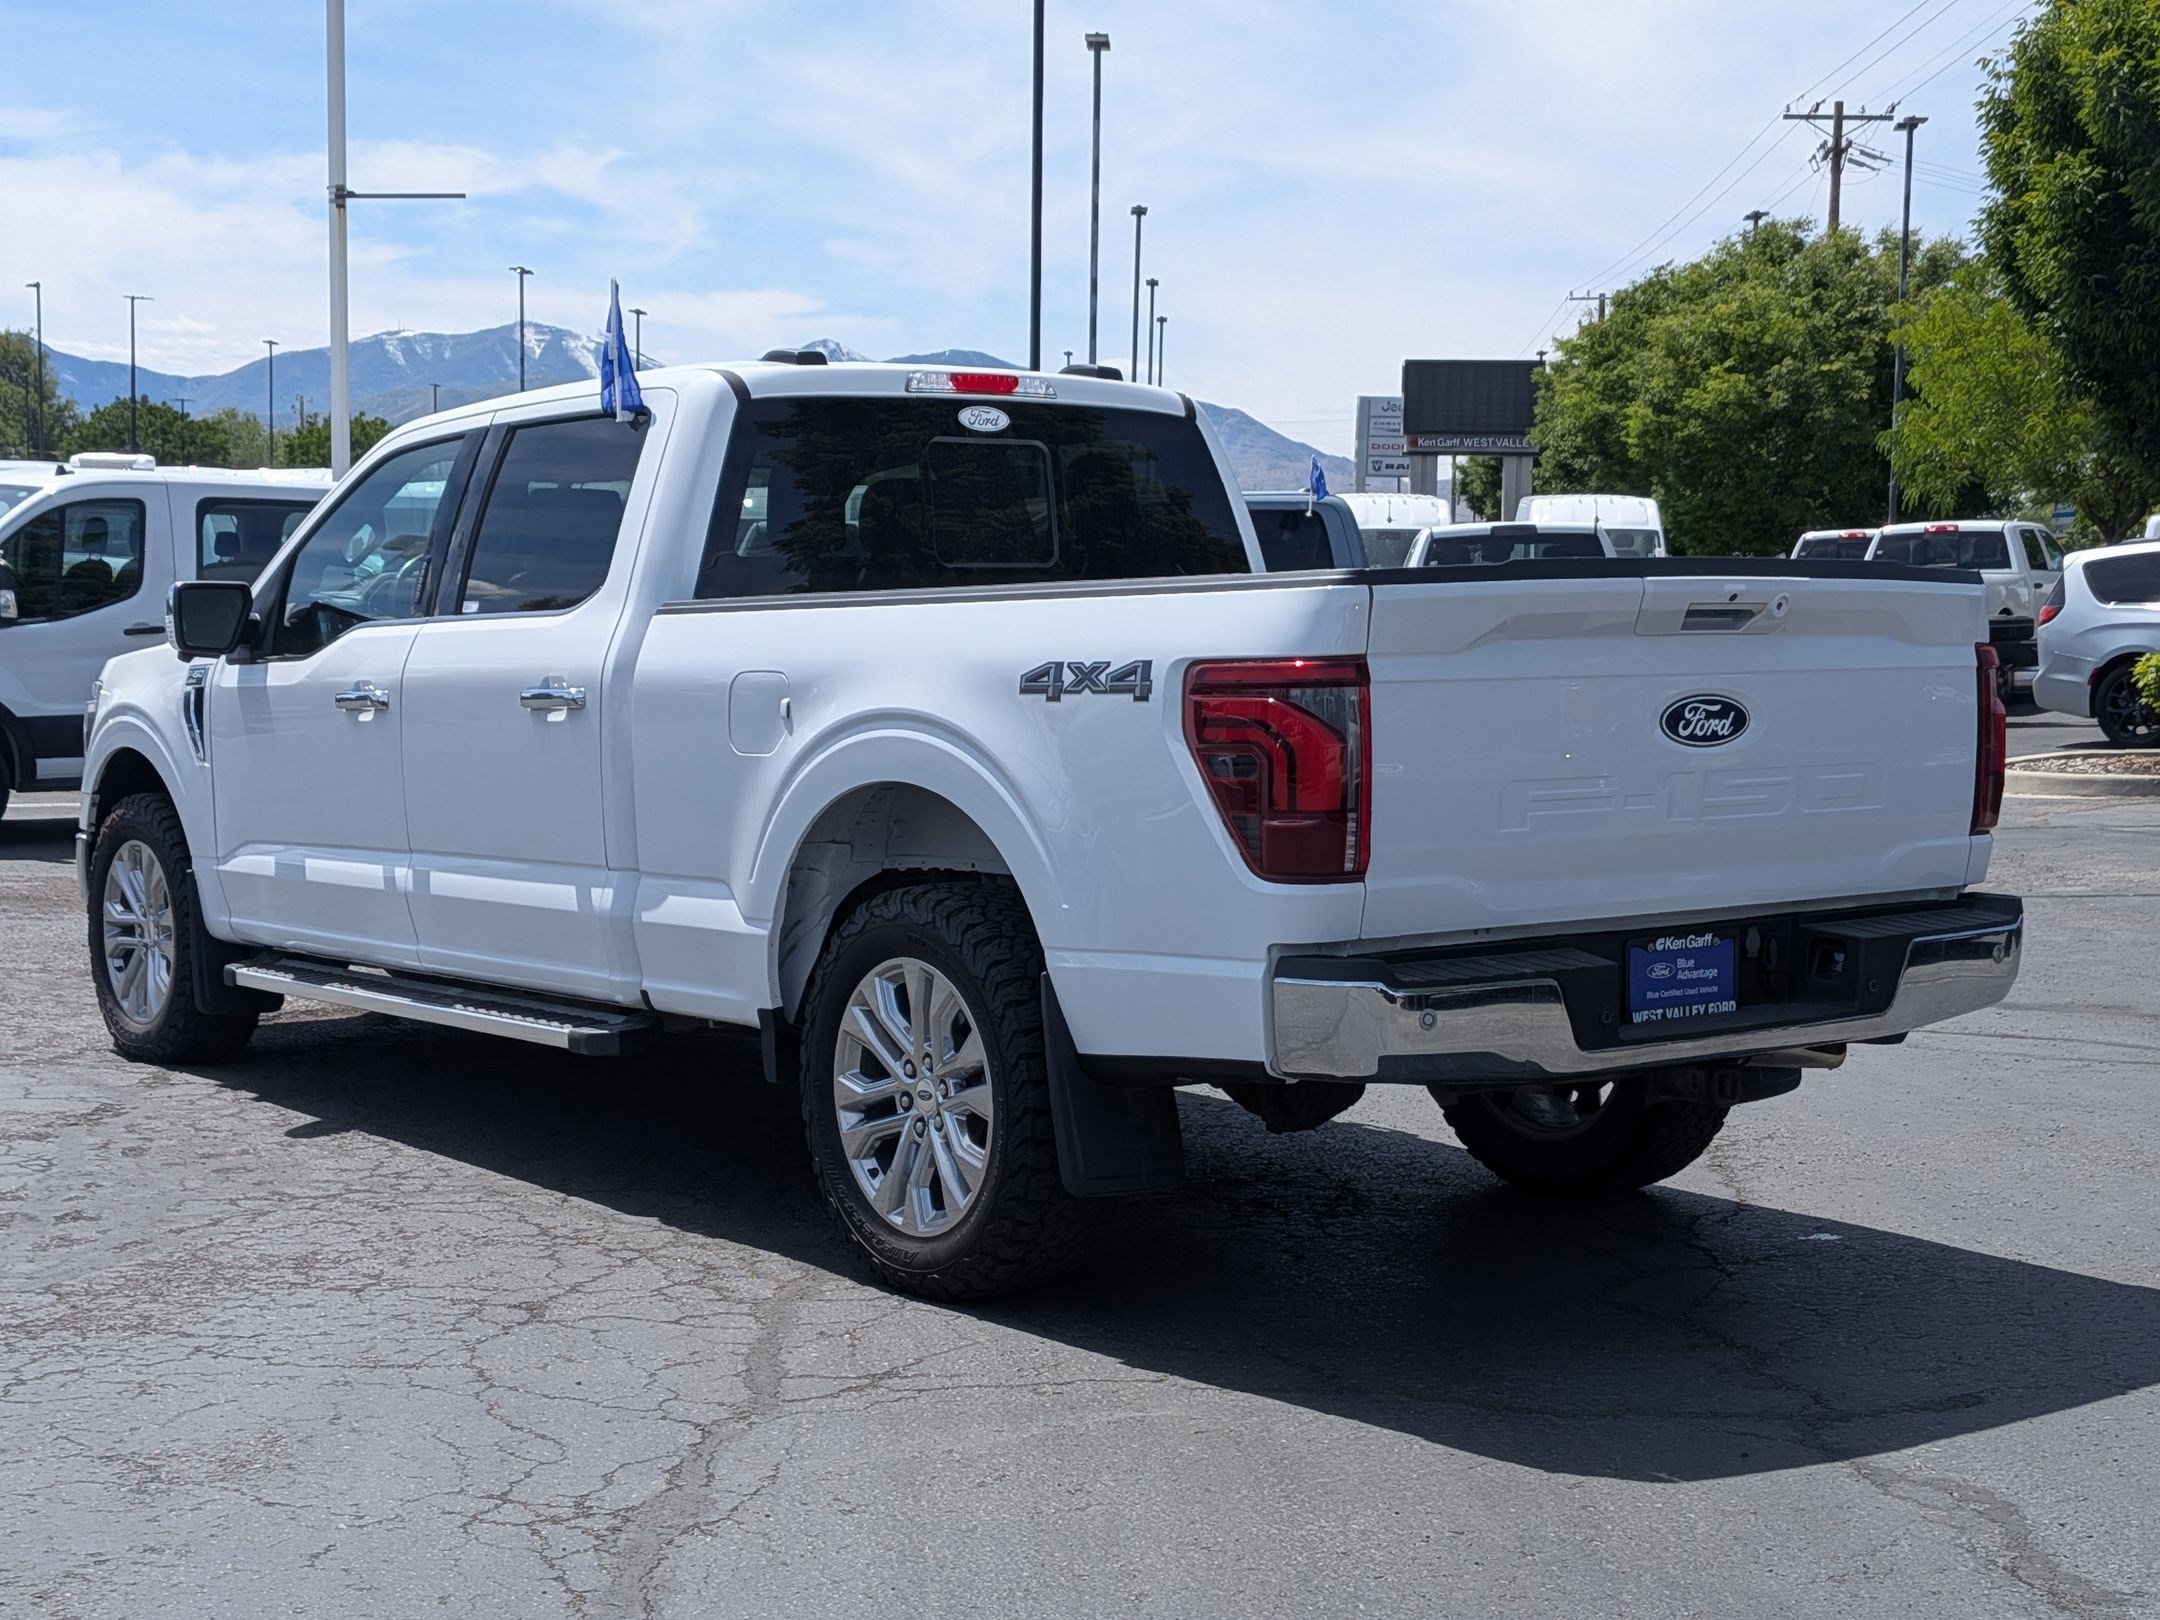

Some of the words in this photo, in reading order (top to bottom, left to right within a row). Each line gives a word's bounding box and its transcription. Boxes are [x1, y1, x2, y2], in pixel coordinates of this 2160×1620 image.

[967, 409, 1001, 428] Ford
[1417, 437, 1436, 447] Ken
[1437, 437, 1460, 447] Garff
[1463, 437, 1494, 448] WEST
[1678, 702, 1735, 738] Ford
[1665, 936, 1686, 950] Ken
[1686, 933, 1713, 948] Garff
[1676, 958, 1695, 969] Blue
[1676, 968, 1718, 980] Advantage
[1632, 1009, 1664, 1023] WEST
[1666, 1004, 1705, 1019] VALLEY
[1708, 1000, 1736, 1014] FORD
